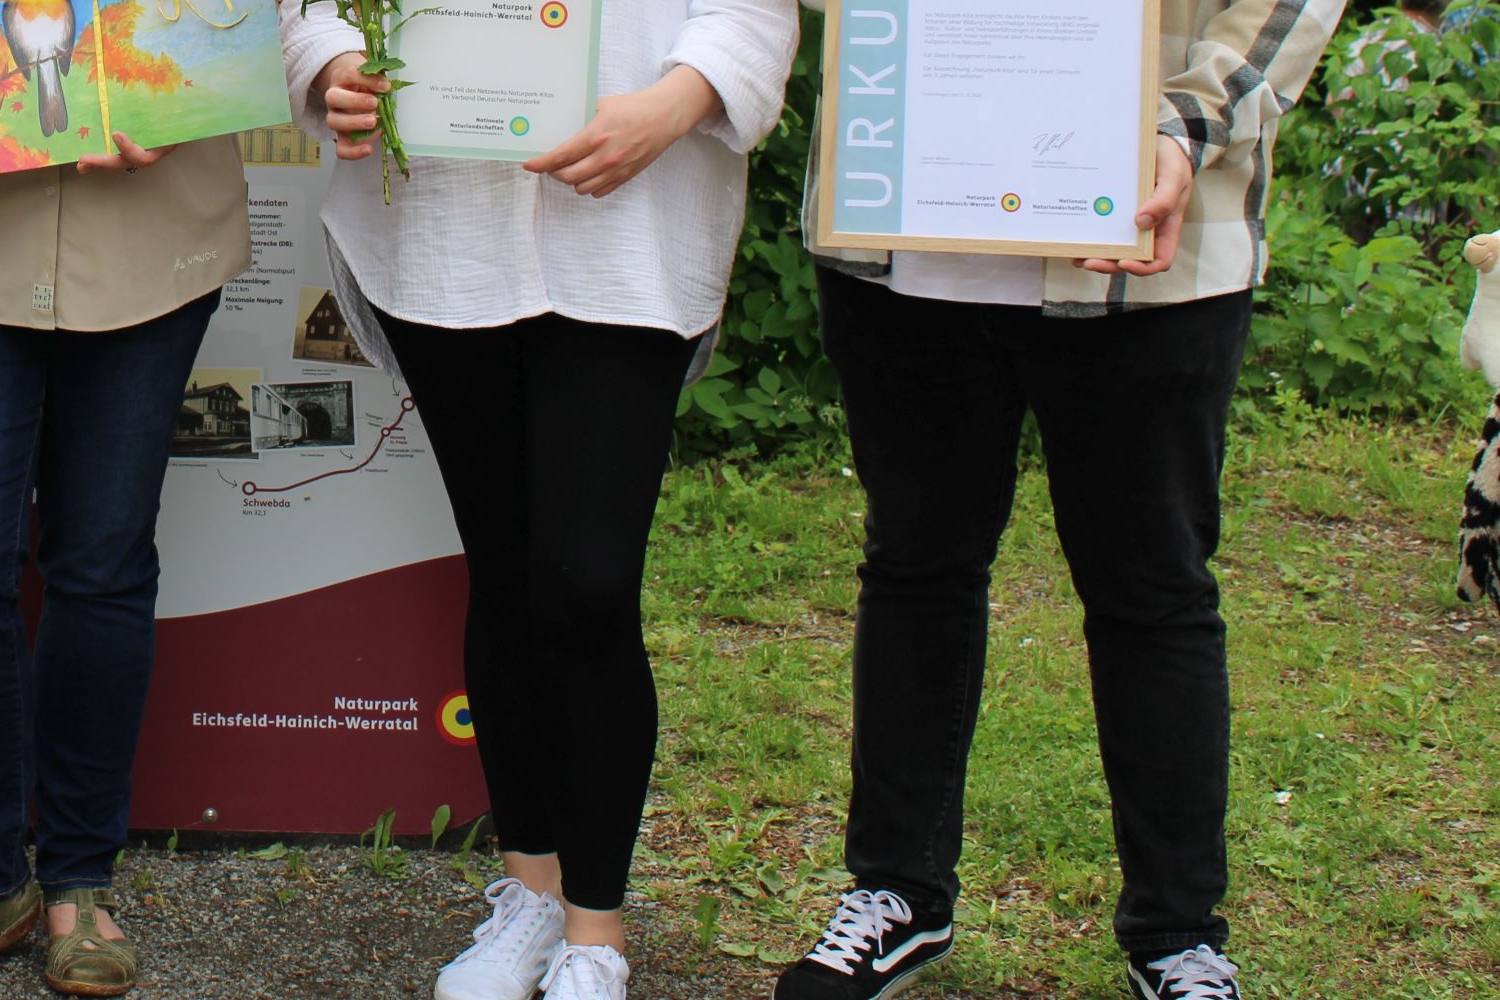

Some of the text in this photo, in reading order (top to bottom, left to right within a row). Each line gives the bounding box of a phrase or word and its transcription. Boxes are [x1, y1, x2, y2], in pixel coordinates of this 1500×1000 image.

[492, 2, 532, 12] Naturpark
[249, 198, 288, 206] kendaten
[187, 250, 218, 264] VAUDE
[243, 498, 290, 508] Schwebda
[334, 696, 418, 714] Naturpark
[192, 712, 418, 731] Eichsfeld-Hainich-Werratal
